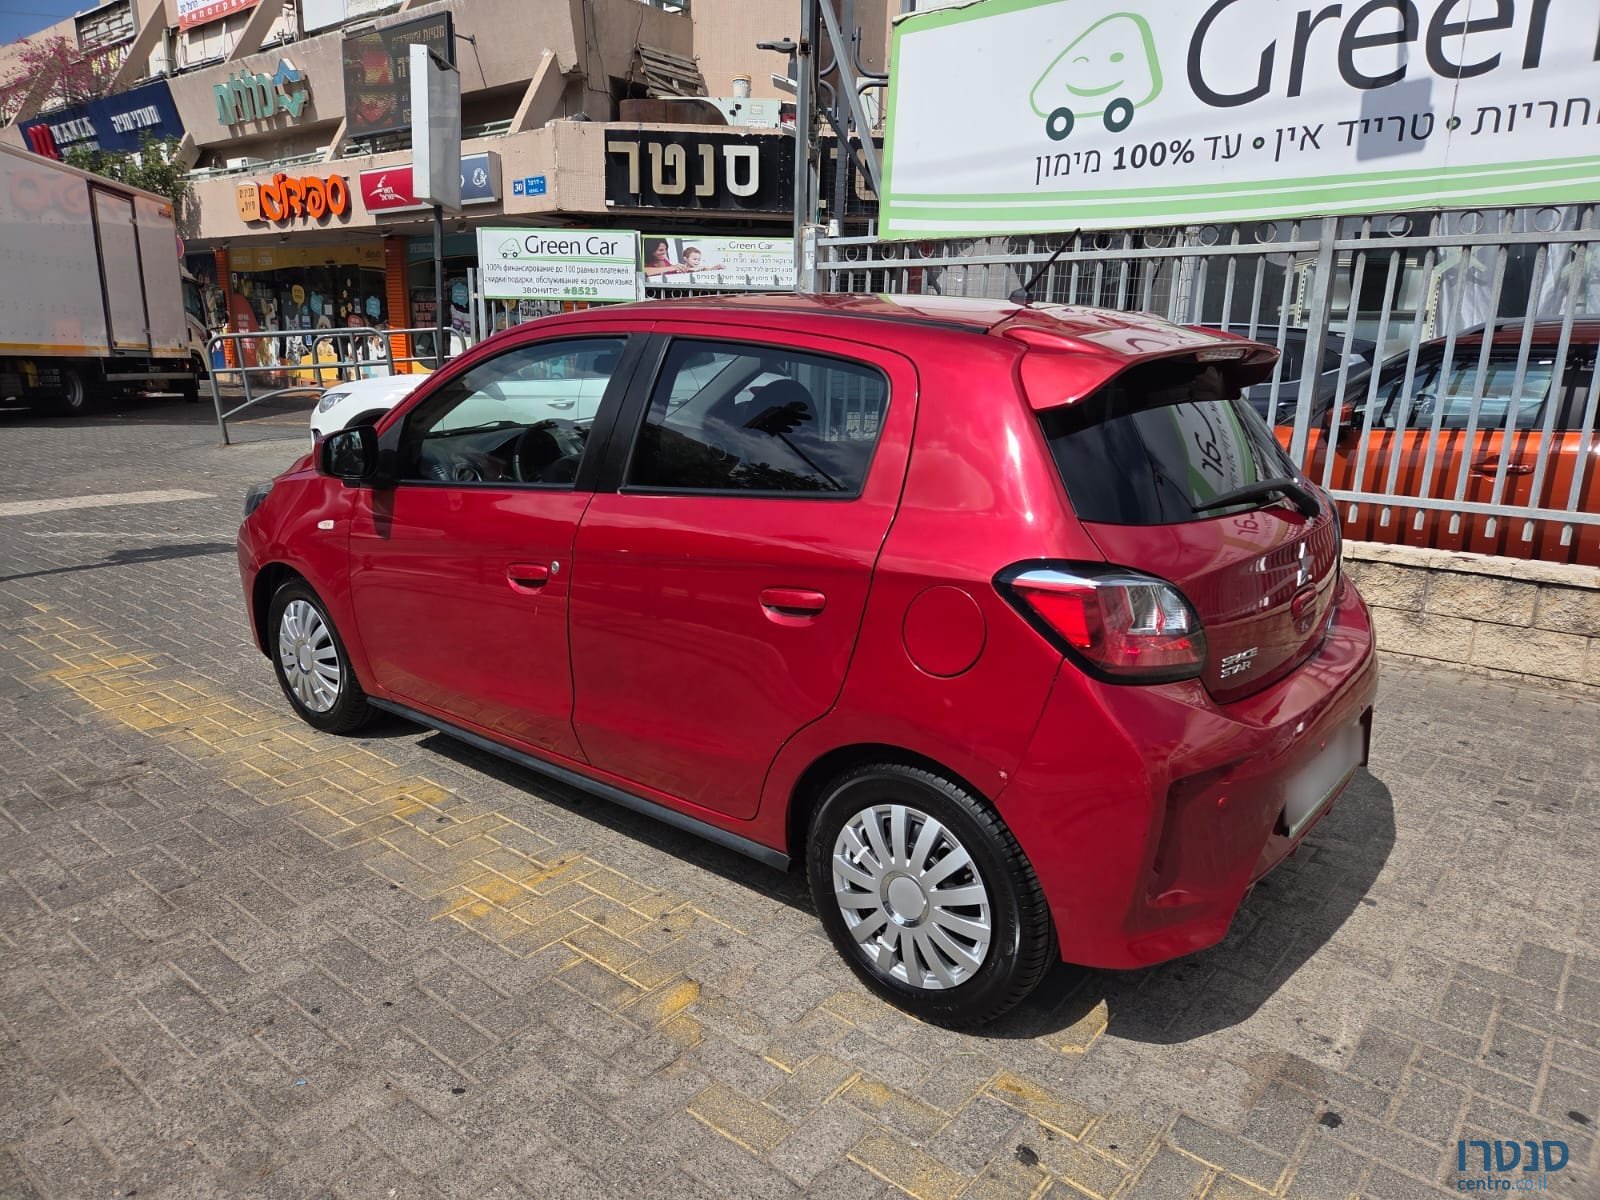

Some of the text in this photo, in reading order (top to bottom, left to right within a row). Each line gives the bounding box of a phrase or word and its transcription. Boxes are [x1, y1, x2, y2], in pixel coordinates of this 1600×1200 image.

[50, 116, 97, 144] MANIA
[1036, 97, 1600, 185] חריות טרייד אין עד 100% מימון
[608, 140, 760, 197] סנטר
[514, 183, 523, 192] 30
[525, 235, 618, 256] Green Car
[729, 241, 775, 250] Green Car
[565, 265, 575, 273] 100
[1222, 646, 1259, 668] SPACE
[1220, 660, 1252, 679] STAR
